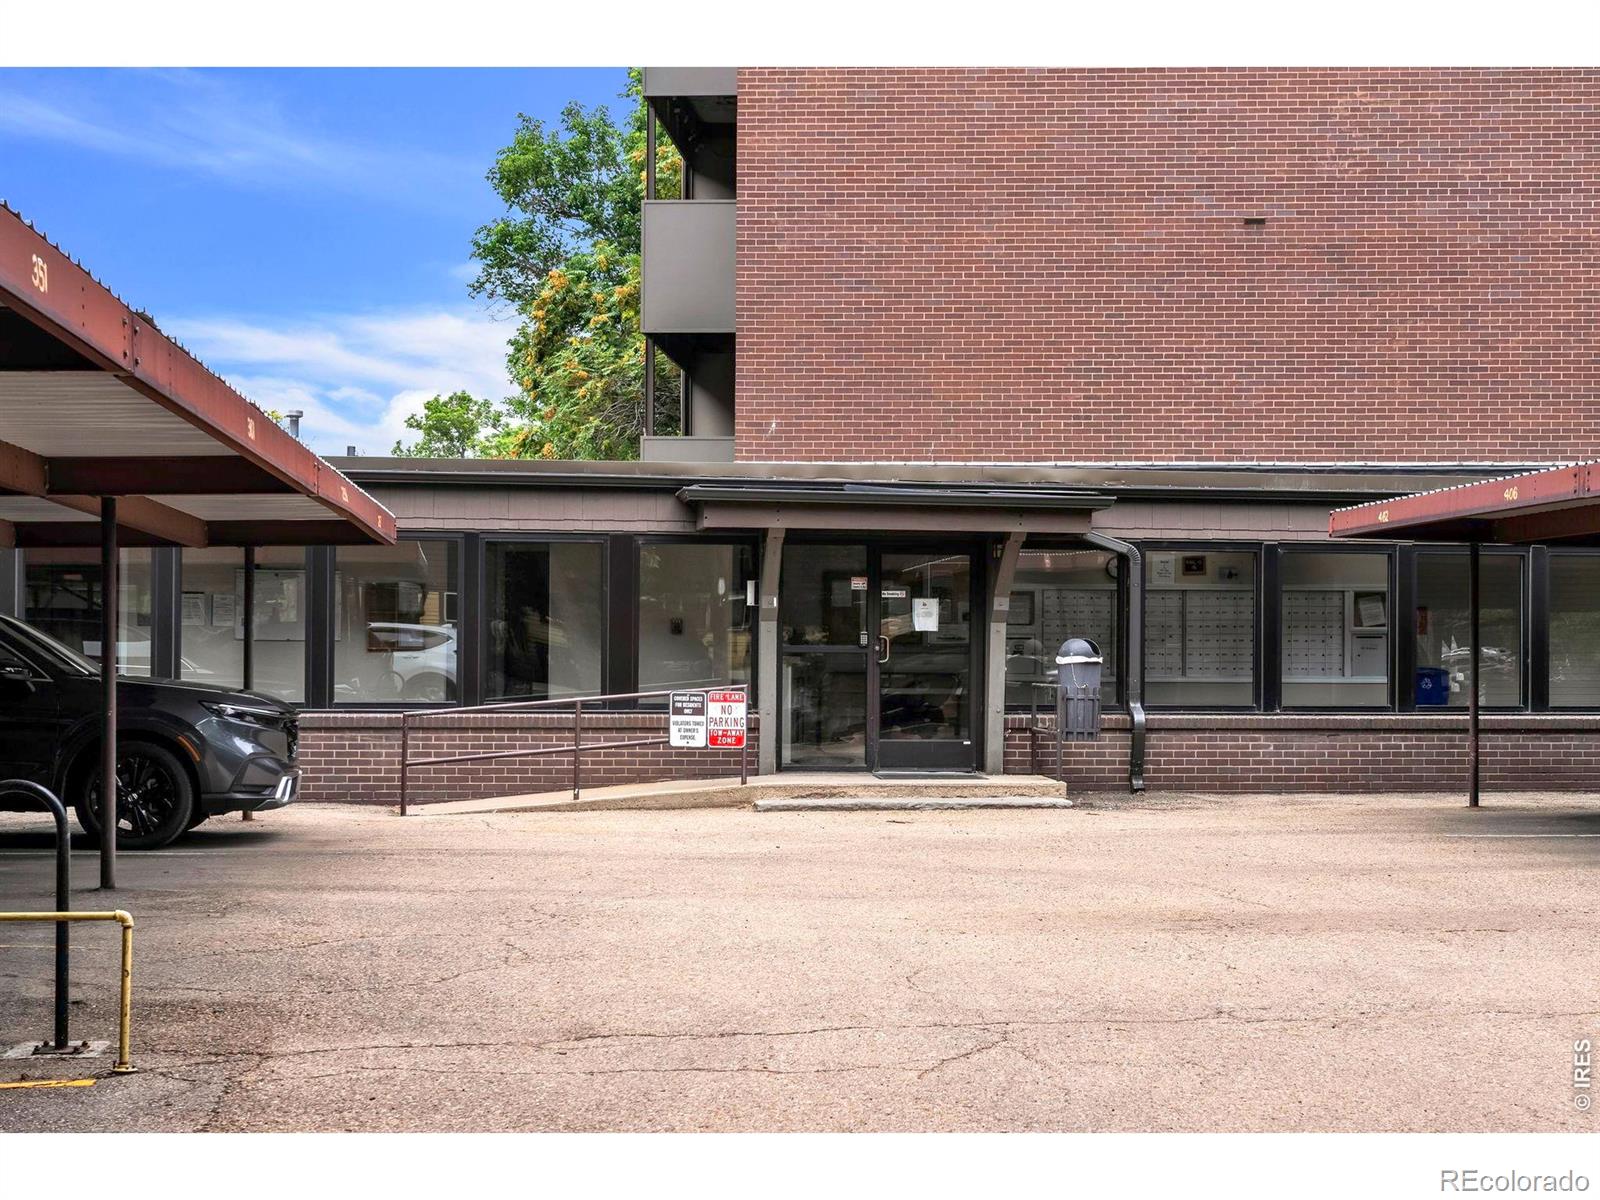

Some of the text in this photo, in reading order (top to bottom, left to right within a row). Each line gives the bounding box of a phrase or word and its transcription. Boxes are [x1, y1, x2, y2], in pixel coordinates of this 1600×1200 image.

[32, 254, 48, 293] 351
[1504, 486, 1518, 500] 406
[720, 704, 733, 715] NO
[709, 717, 744, 728] PARKING
